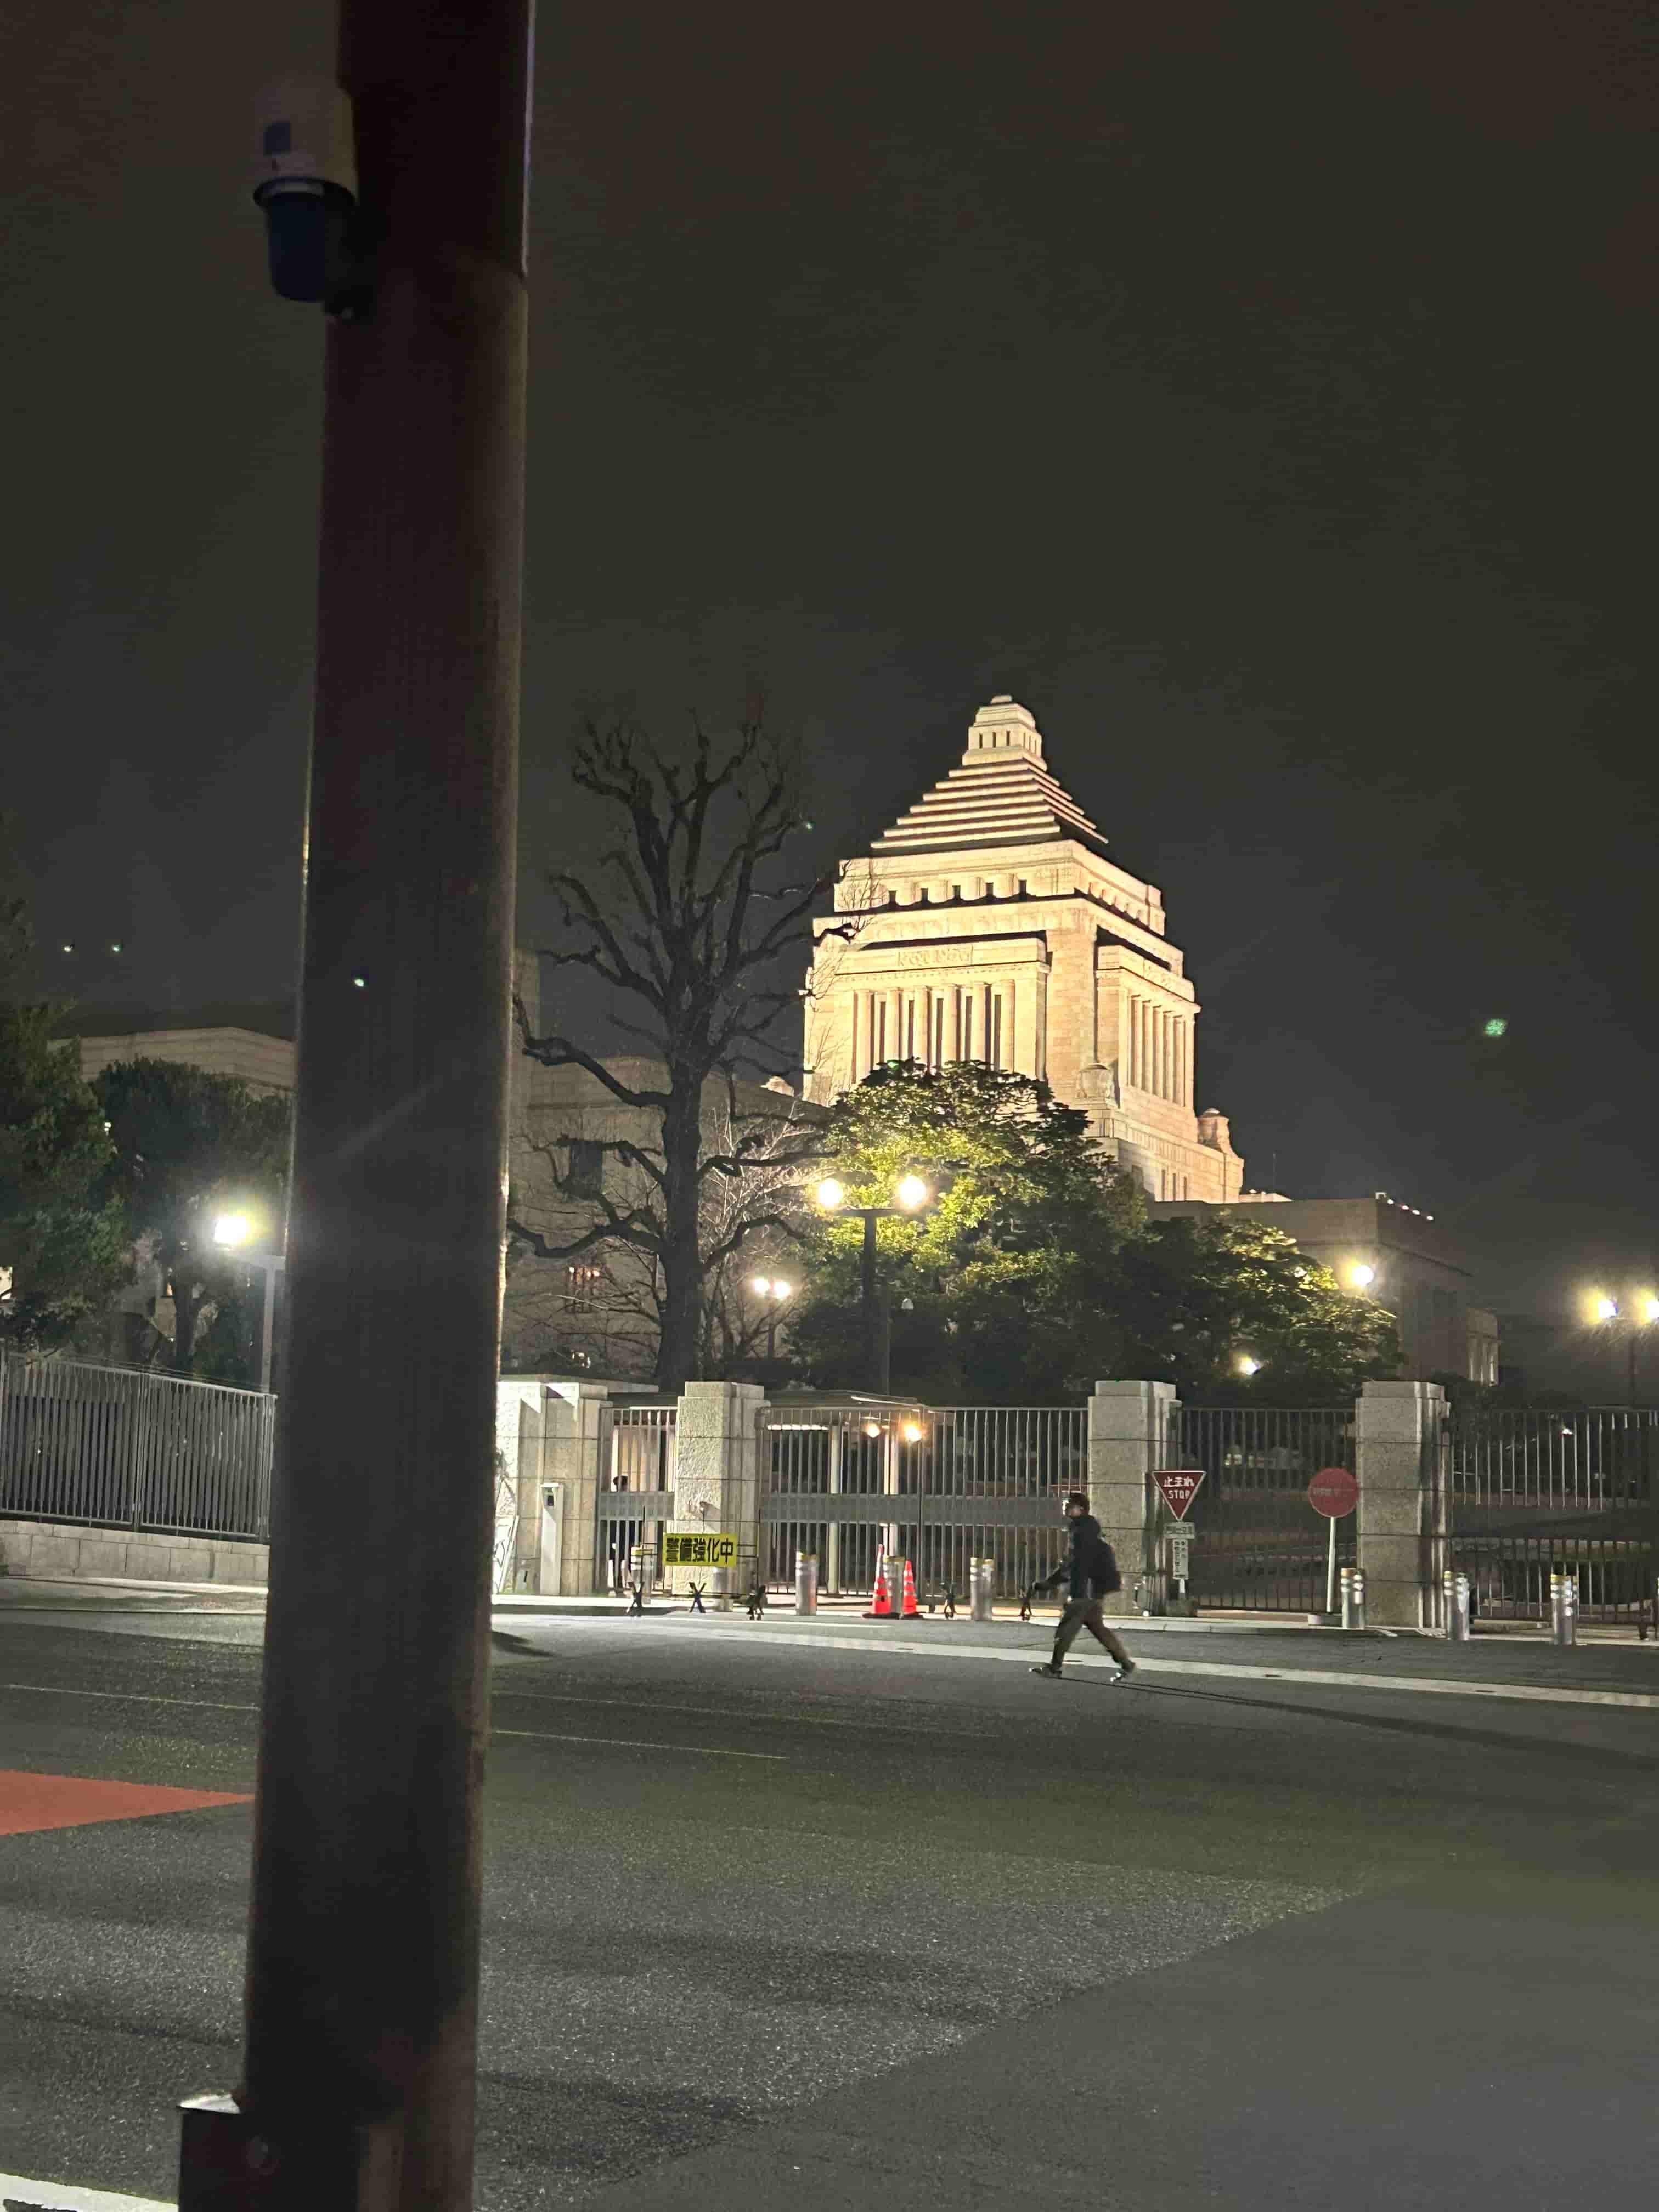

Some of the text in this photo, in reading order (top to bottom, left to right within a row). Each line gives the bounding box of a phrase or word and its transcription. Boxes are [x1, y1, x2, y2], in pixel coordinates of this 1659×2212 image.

[1168, 1490, 1190, 1499] STOP
[666, 1537, 733, 1564] 警備強化中
